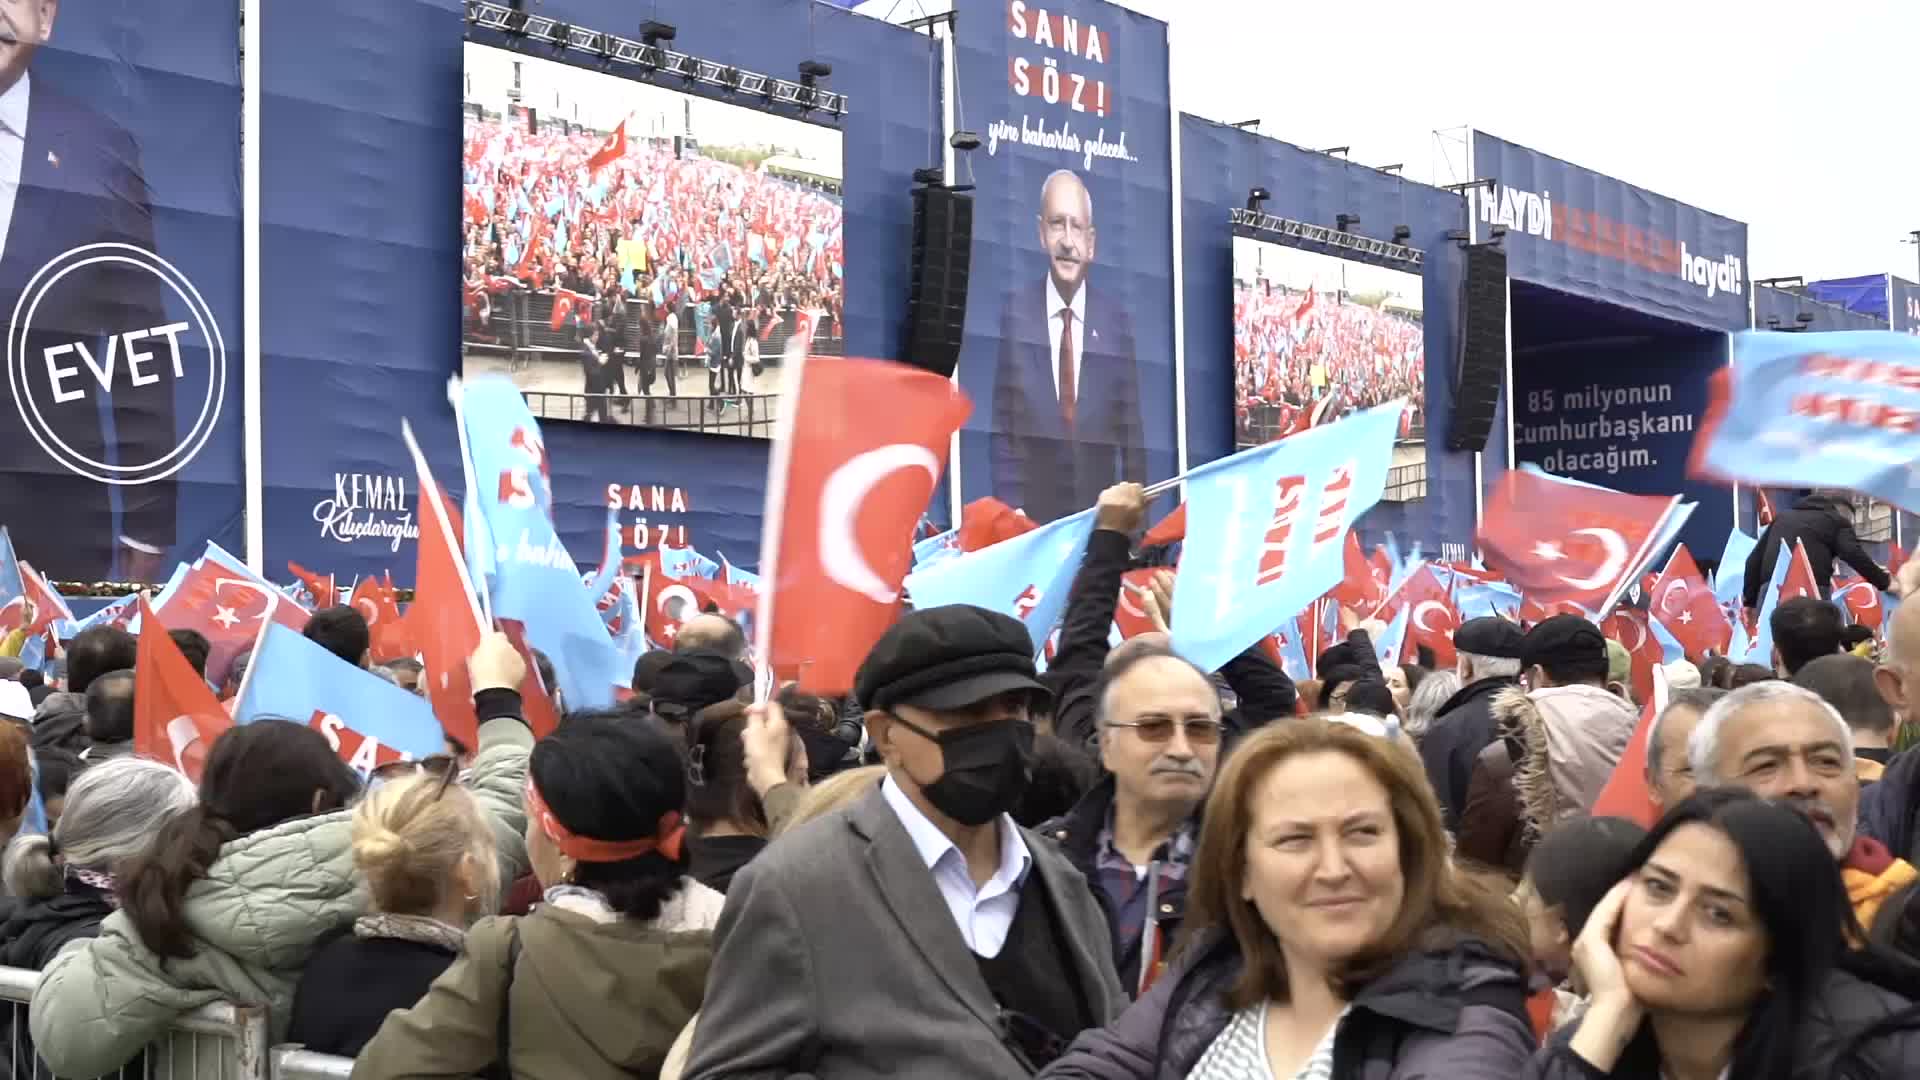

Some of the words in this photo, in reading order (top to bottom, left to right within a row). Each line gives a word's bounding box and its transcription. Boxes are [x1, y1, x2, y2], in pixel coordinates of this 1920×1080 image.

[1011, 0, 1103, 63] SANA
[1014, 57, 1104, 116] SÖZ!
[988, 119, 1020, 156] yine
[1021, 115, 1082, 153] baharlar
[1681, 241, 1742, 298] haydi!
[43, 321, 190, 403] EVET
[1528, 391, 1554, 412] 85
[1564, 384, 1672, 412] milyonun
[1514, 411, 1693, 444] Cumhurbaşkanı
[1543, 445, 1658, 474] olacağım.
[335, 473, 408, 511] KEMAL
[607, 483, 686, 513] SANA
